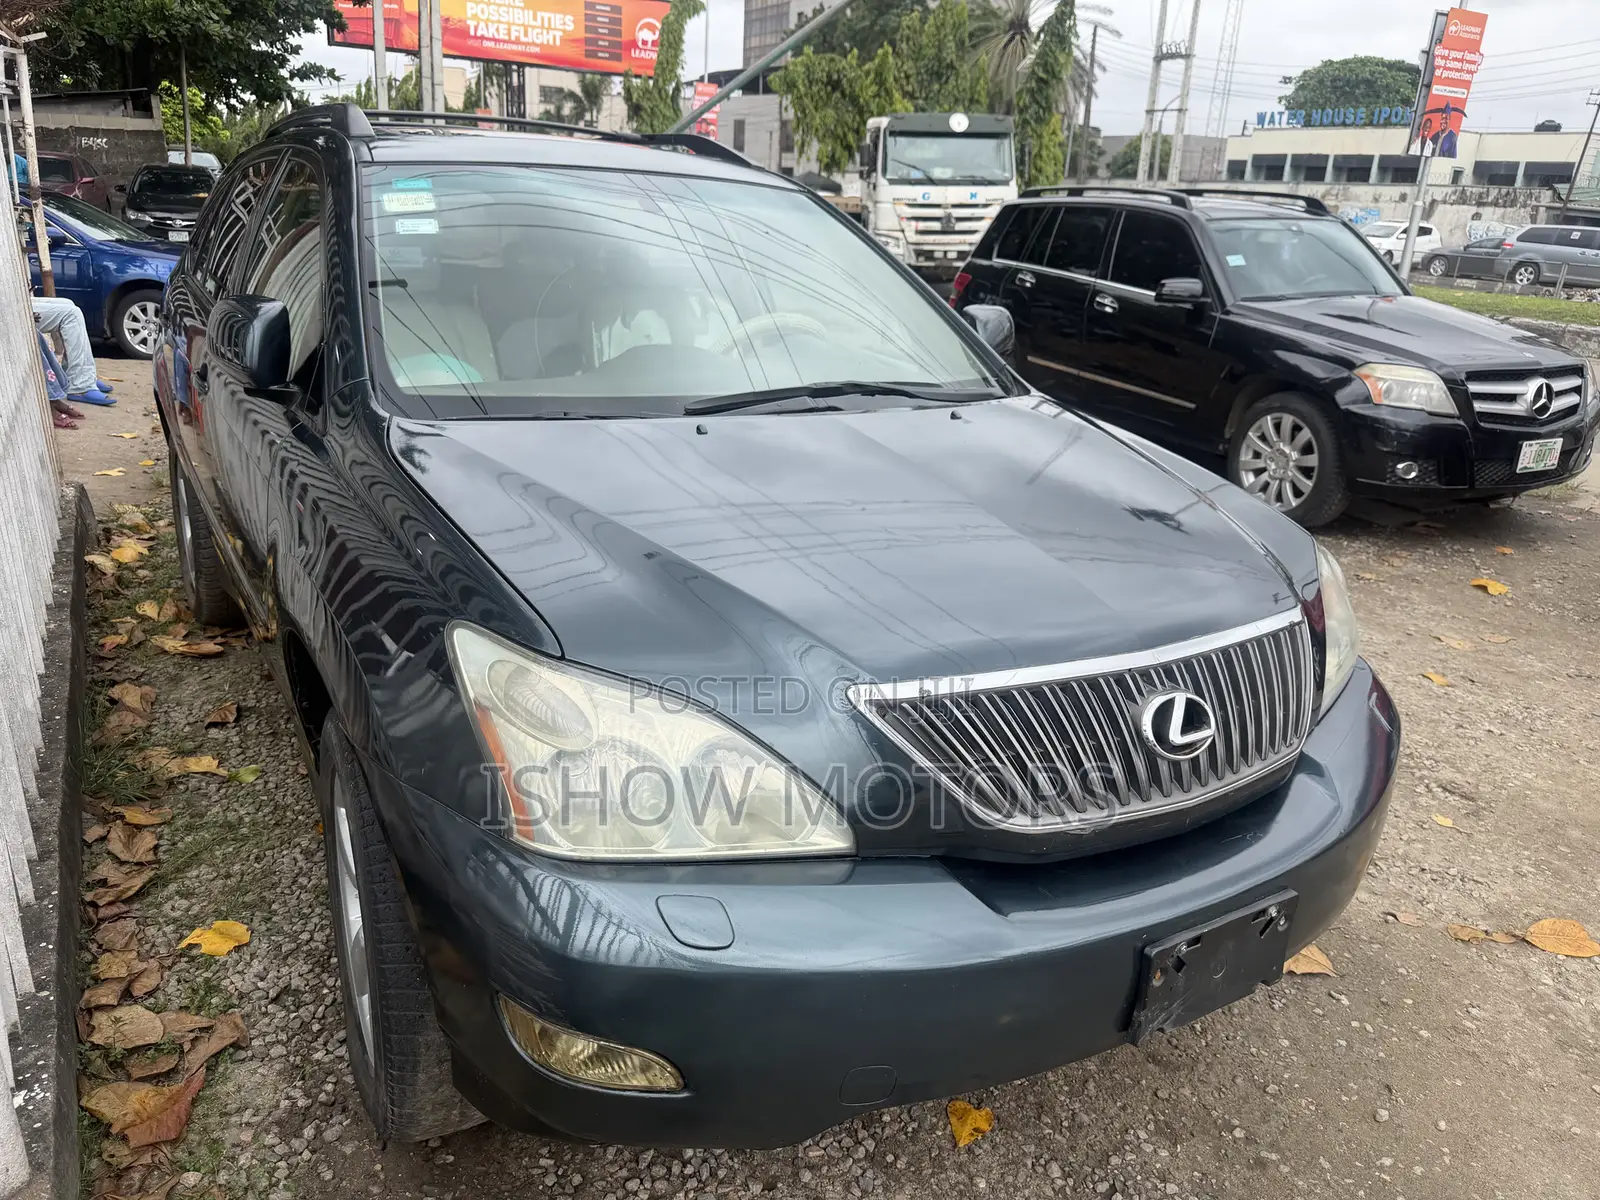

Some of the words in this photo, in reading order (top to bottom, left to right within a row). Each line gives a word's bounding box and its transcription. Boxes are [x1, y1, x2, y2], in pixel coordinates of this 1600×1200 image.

[466, 2, 575, 31] POSSIBILITIES
[466, 20, 509, 40] TAKE
[510, 25, 563, 46] FLIGHT
[1434, 45, 1449, 57] Give
[1449, 50, 1464, 60] your
[1464, 51, 1483, 64] family
[1435, 57, 1447, 67] the
[1447, 59, 1462, 70] same
[1462, 61, 1478, 72] level
[1435, 68, 1443, 77] of
[1442, 69, 1473, 81] protection
[1257, 109, 1305, 128] WATER
[1311, 107, 1366, 126] HOUSE
